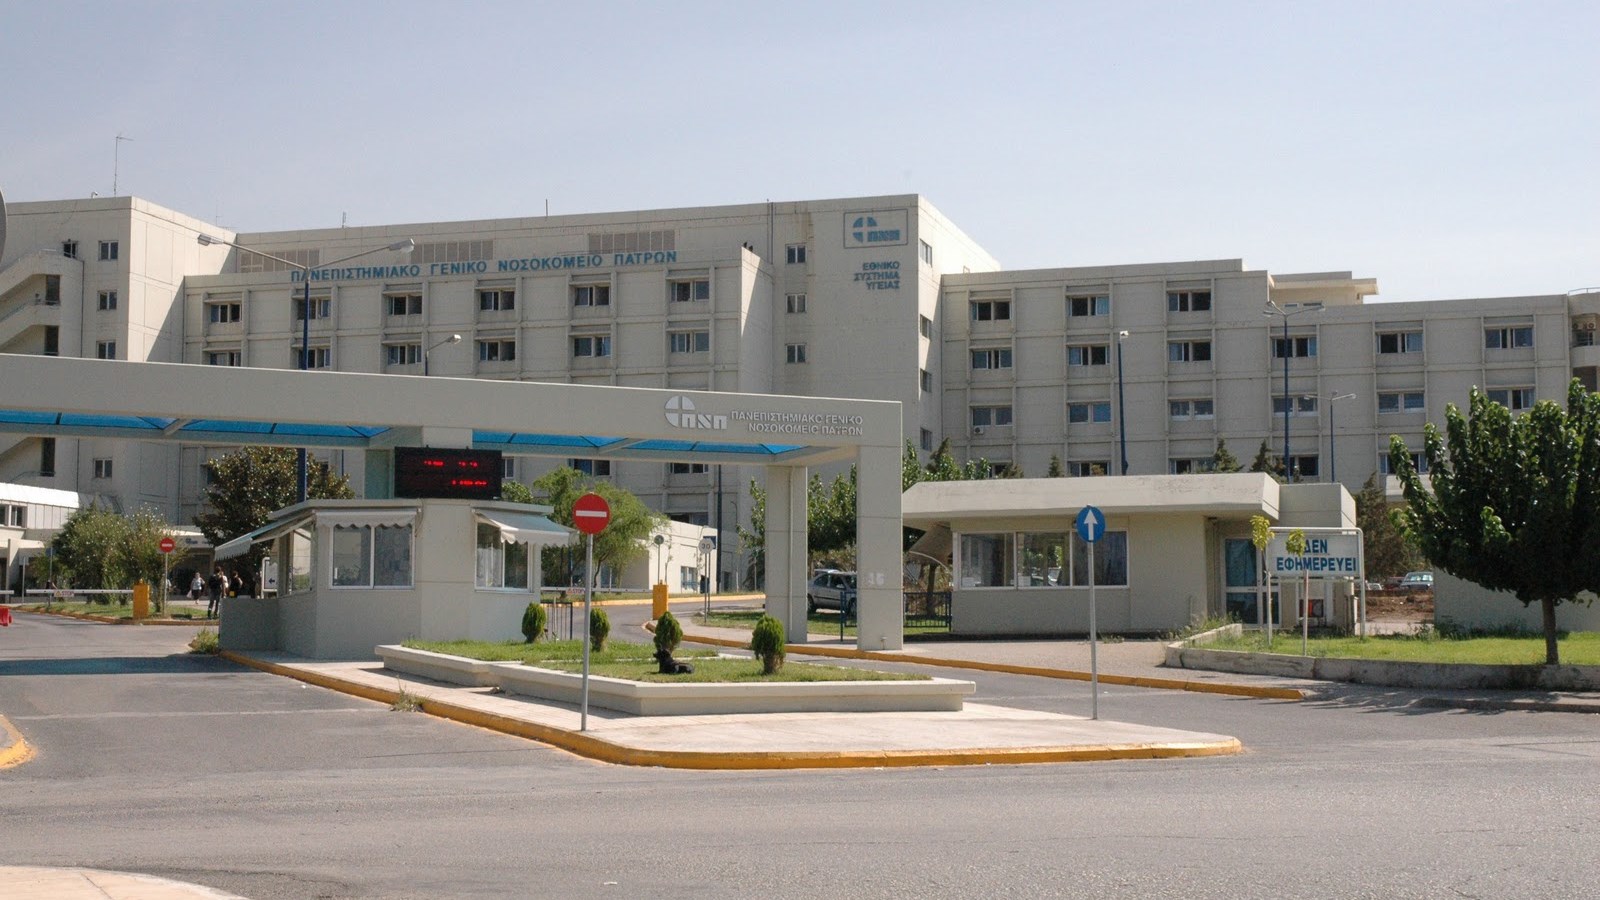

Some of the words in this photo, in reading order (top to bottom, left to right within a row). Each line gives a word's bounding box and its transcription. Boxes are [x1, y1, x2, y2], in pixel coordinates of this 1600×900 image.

[430, 261, 487, 275] ΓΕΝΙΚΟ
[498, 254, 602, 272] ΝΟΣΟΚΟΜΕΙΟ
[614, 251, 677, 266] ΠΑΤΡΩΝ
[863, 261, 900, 271] ΕΘΝΙΚΟ
[854, 271, 900, 282] ΣΥΣΤΗΜΑ
[866, 281, 900, 290] ΥΓΕΙΑΣ
[731, 411, 823, 424] ΠΑΝΕΠΙΣΤΗΜΙΑΚΟ
[825, 414, 864, 425] ΓΕΝΙΚΟ
[748, 423, 819, 434] ΝΟΣΟΚΟΜΕΙΟ
[821, 425, 863, 436] ΠΑΤΡΩΝ
[1303, 539, 1328, 553] ΔΕΝ
[1276, 557, 1356, 571] ΕΦΗΜΕΡΕΥΕΙ
